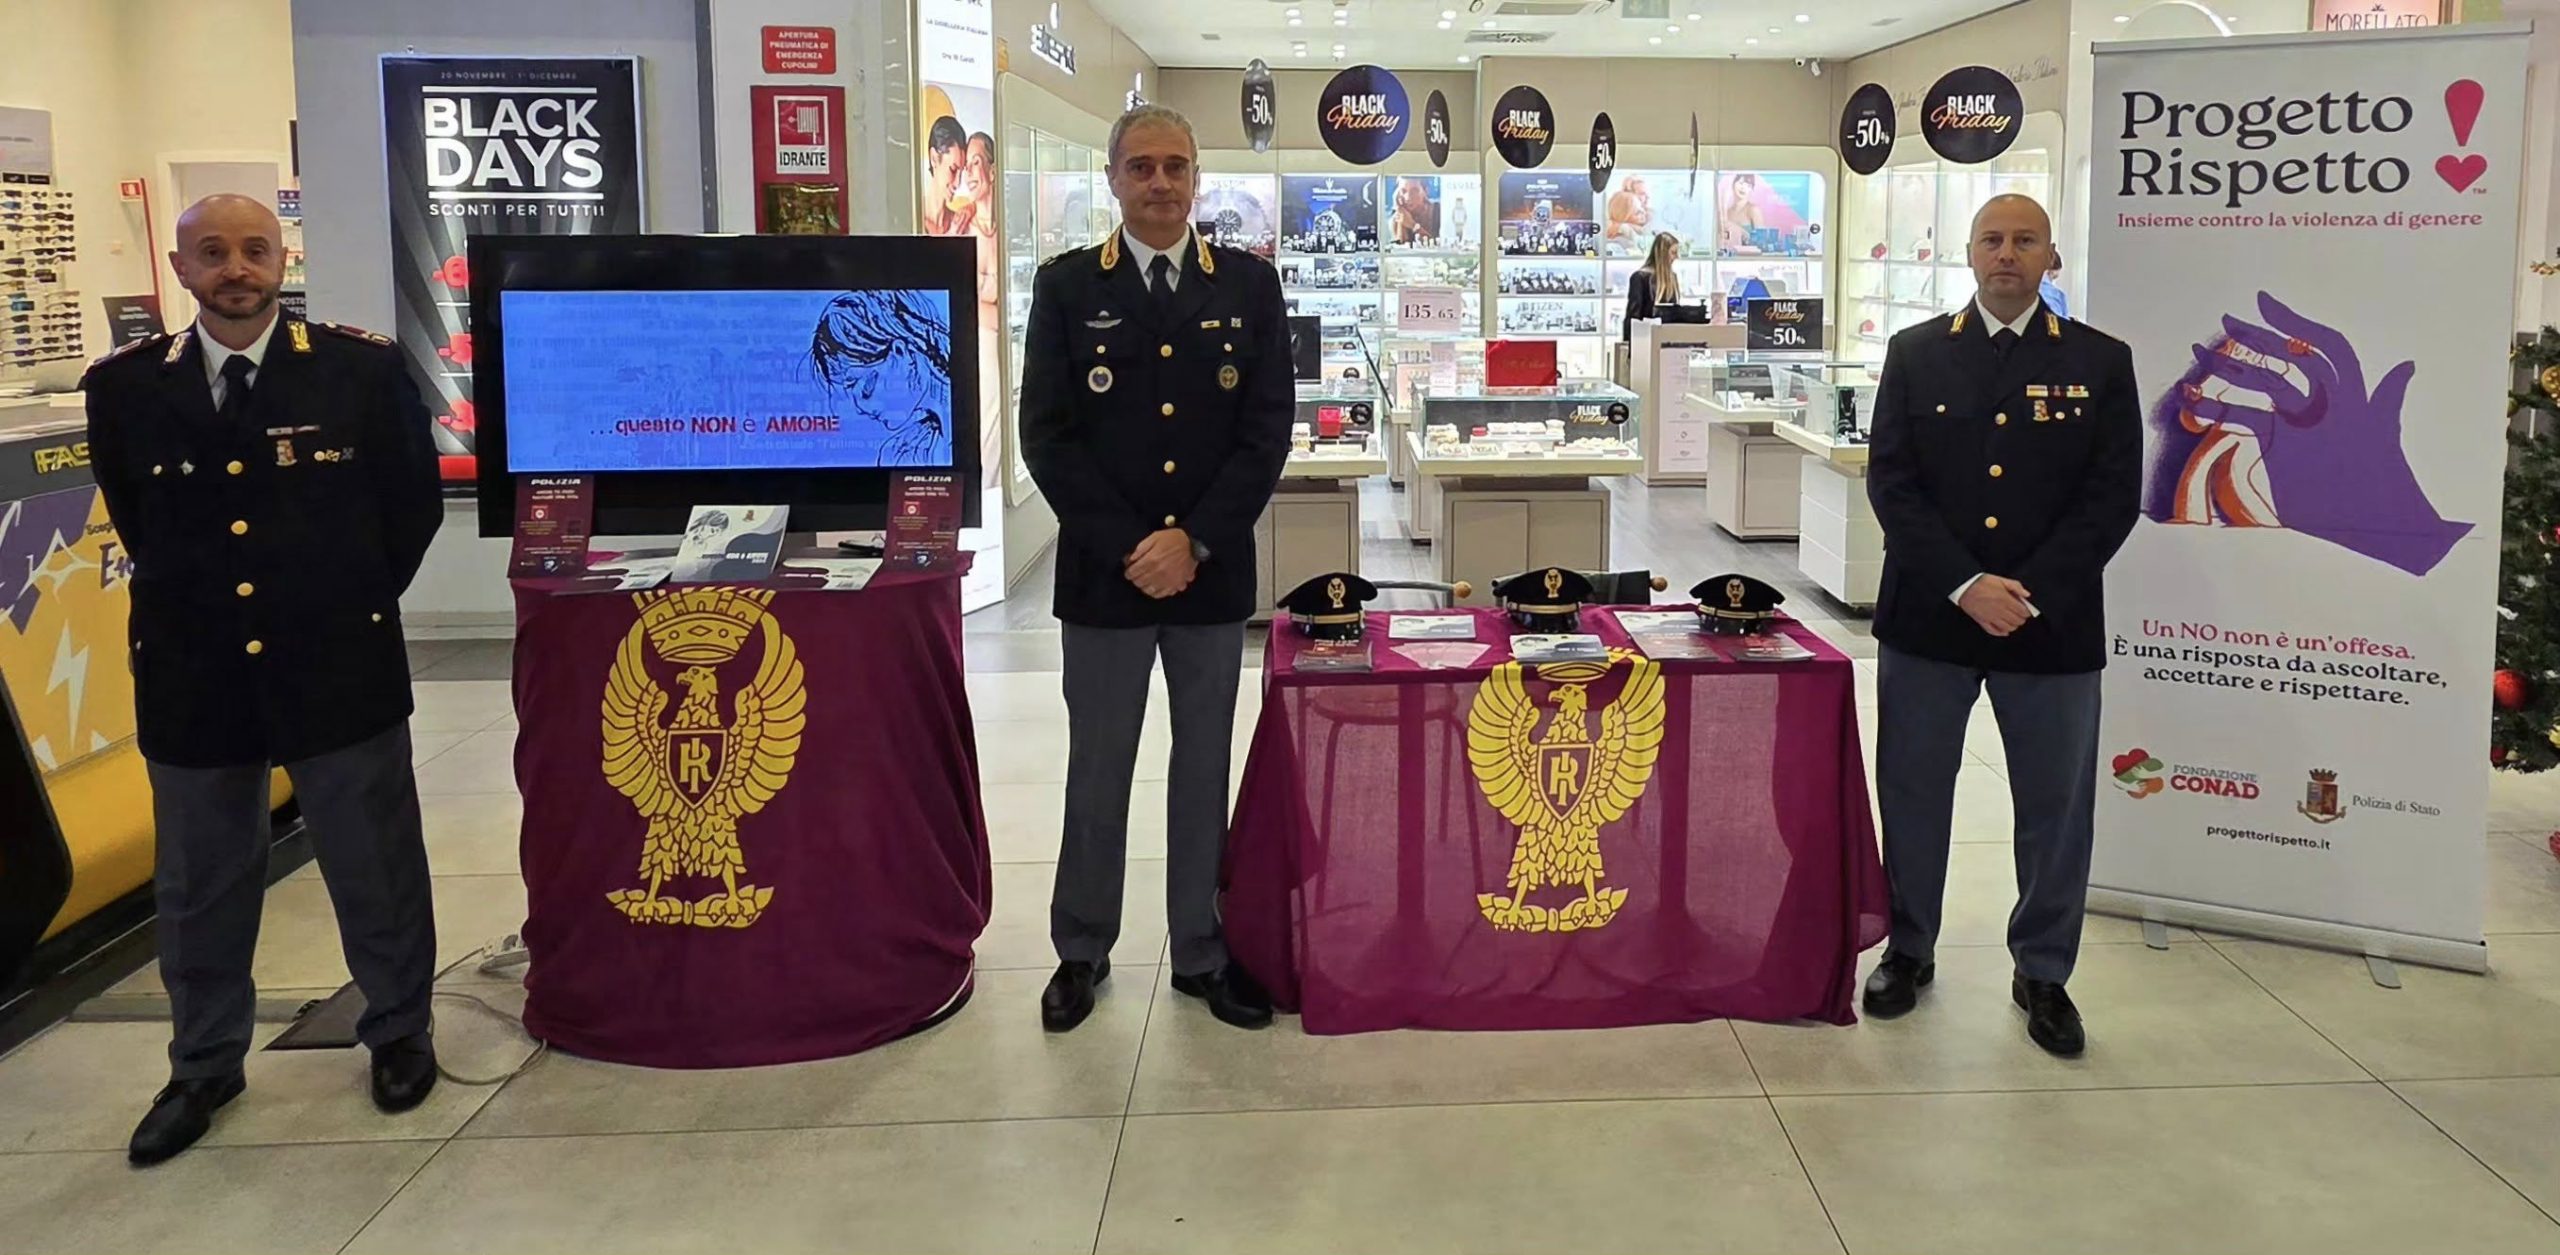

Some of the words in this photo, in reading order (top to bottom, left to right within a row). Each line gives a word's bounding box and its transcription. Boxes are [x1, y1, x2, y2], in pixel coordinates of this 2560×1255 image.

[778, 31, 819, 39] APERTURA
[776, 51, 823, 60] EMERGENZA
[456, 72, 506, 80] NOVEMBRE
[1342, 94, 1387, 116] BLACK
[1947, 94, 1996, 115] BLACK
[424, 98, 600, 137] BLACK
[1327, 104, 1401, 134] Friday
[1509, 109, 1541, 128] BLACK
[1930, 104, 2012, 134] Friday
[2120, 90, 2413, 150] Progetto
[1498, 117, 1550, 145] Friday
[1847, 117, 1890, 148] -50%
[425, 138, 604, 189] DAYS
[779, 151, 827, 167] IDRANTE
[2118, 147, 2410, 208] Rispetto
[429, 203, 497, 217] SCONTI
[506, 204, 538, 217] PER
[2117, 212, 2195, 228] Insieme
[2199, 214, 2265, 228] contro
[2268, 212, 2288, 227] la
[2291, 211, 2378, 227] violenza
[2382, 210, 2404, 226] di
[2409, 212, 2484, 230] genere
[432, 256, 468, 287] -6
[1765, 307, 1805, 323] Friday
[1773, 302, 1798, 313] BLACK
[691, 416, 737, 433] NON
[743, 416, 757, 433] è
[765, 415, 840, 433] AMORE
[34, 442, 91, 474] FAS
[531, 478, 581, 486] POLIZIA
[904, 475, 952, 483] POLIZIA
[86, 521, 115, 535] Sceg
[2143, 620, 2174, 638] Un
[2180, 623, 2218, 642] NO
[2224, 630, 2270, 647] non
[2276, 630, 2289, 648] è
[2296, 635, 2416, 660] un'offesa.
[2113, 634, 2128, 656] È
[2133, 644, 2177, 661] una
[2182, 648, 2280, 671] risposta
[2286, 654, 2317, 674] da
[2322, 662, 2447, 689] ascoltare,
[2143, 665, 2254, 689] accettare
[2260, 677, 2274, 692] e
[2279, 678, 2410, 706] rispettare.
[2173, 764, 2258, 783] FONDAZIONE
[2170, 774, 2260, 800] CONAD
[2352, 795, 2391, 811] Polizia
[2395, 800, 2406, 812] di
[2410, 801, 2441, 817] Stato
[2207, 824, 2331, 850] progettorispetto.it
